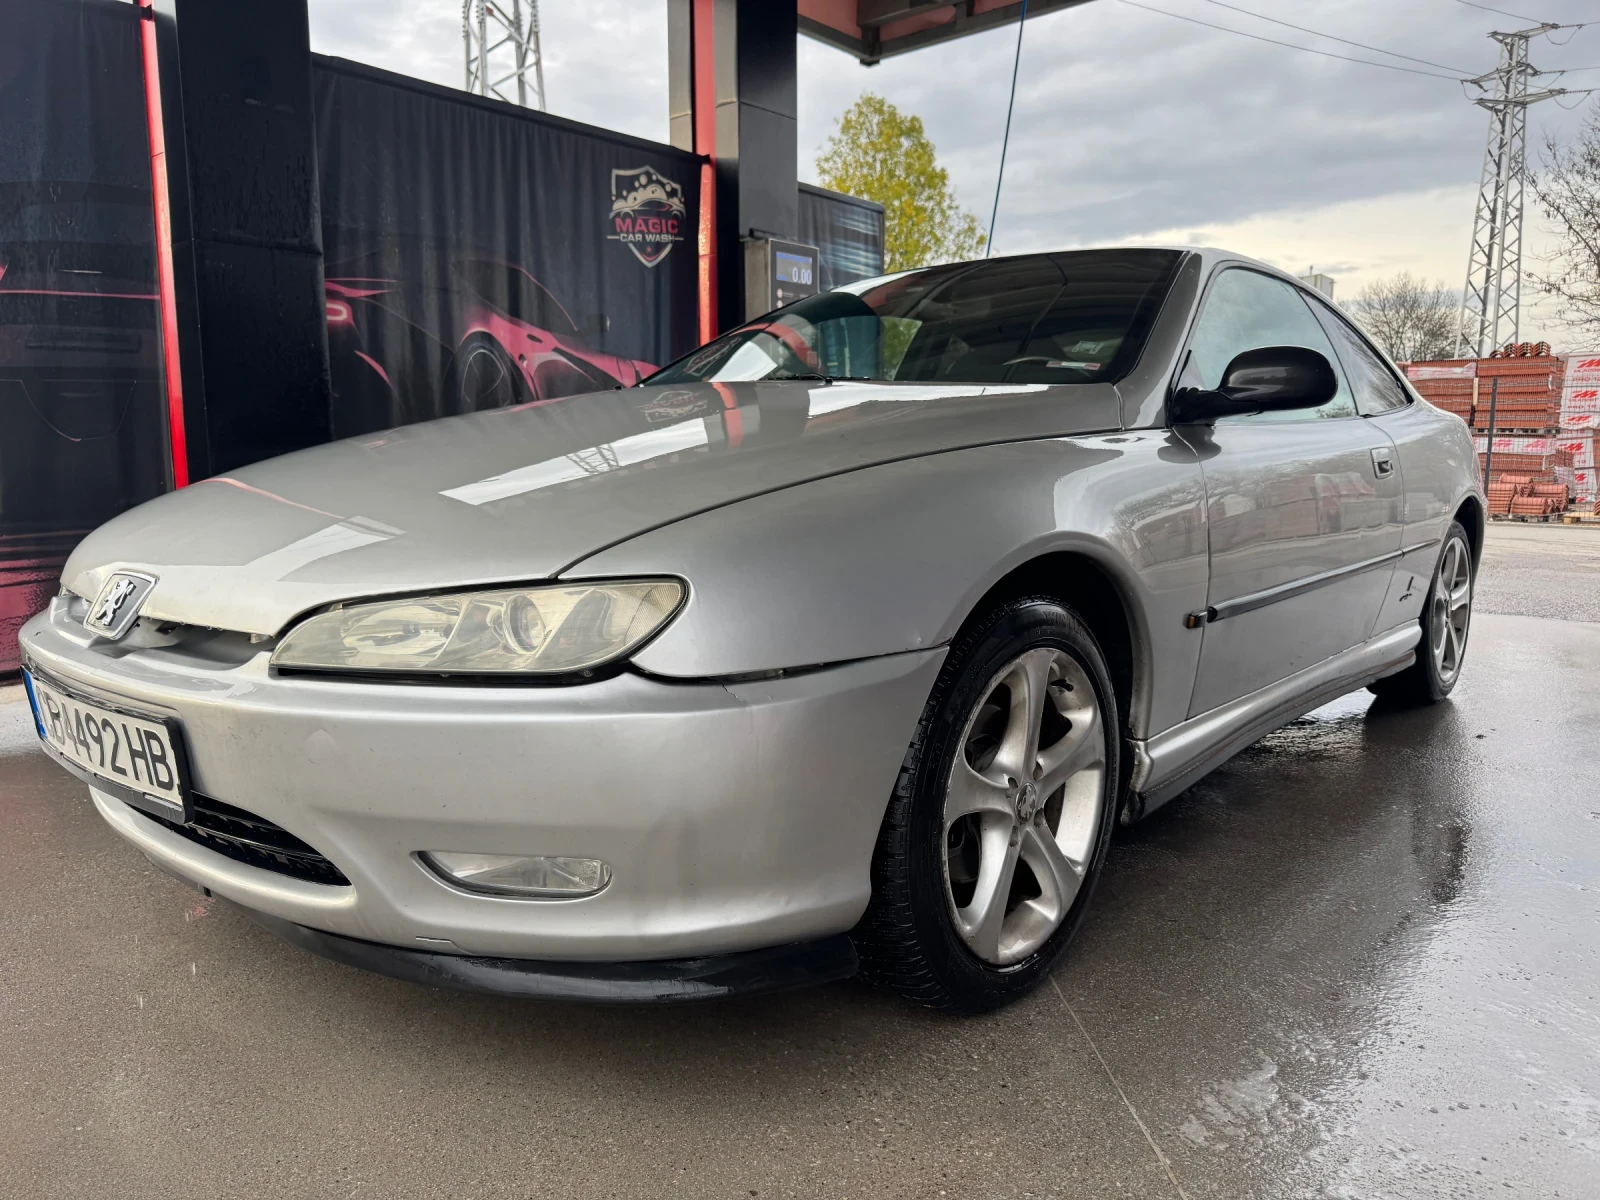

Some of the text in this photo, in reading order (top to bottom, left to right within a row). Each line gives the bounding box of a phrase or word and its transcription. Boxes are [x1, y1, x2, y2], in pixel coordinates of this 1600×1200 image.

[615, 217, 679, 234] MAGIC
[620, 233, 675, 243] CAR WASH
[792, 267, 812, 285] 0.00
